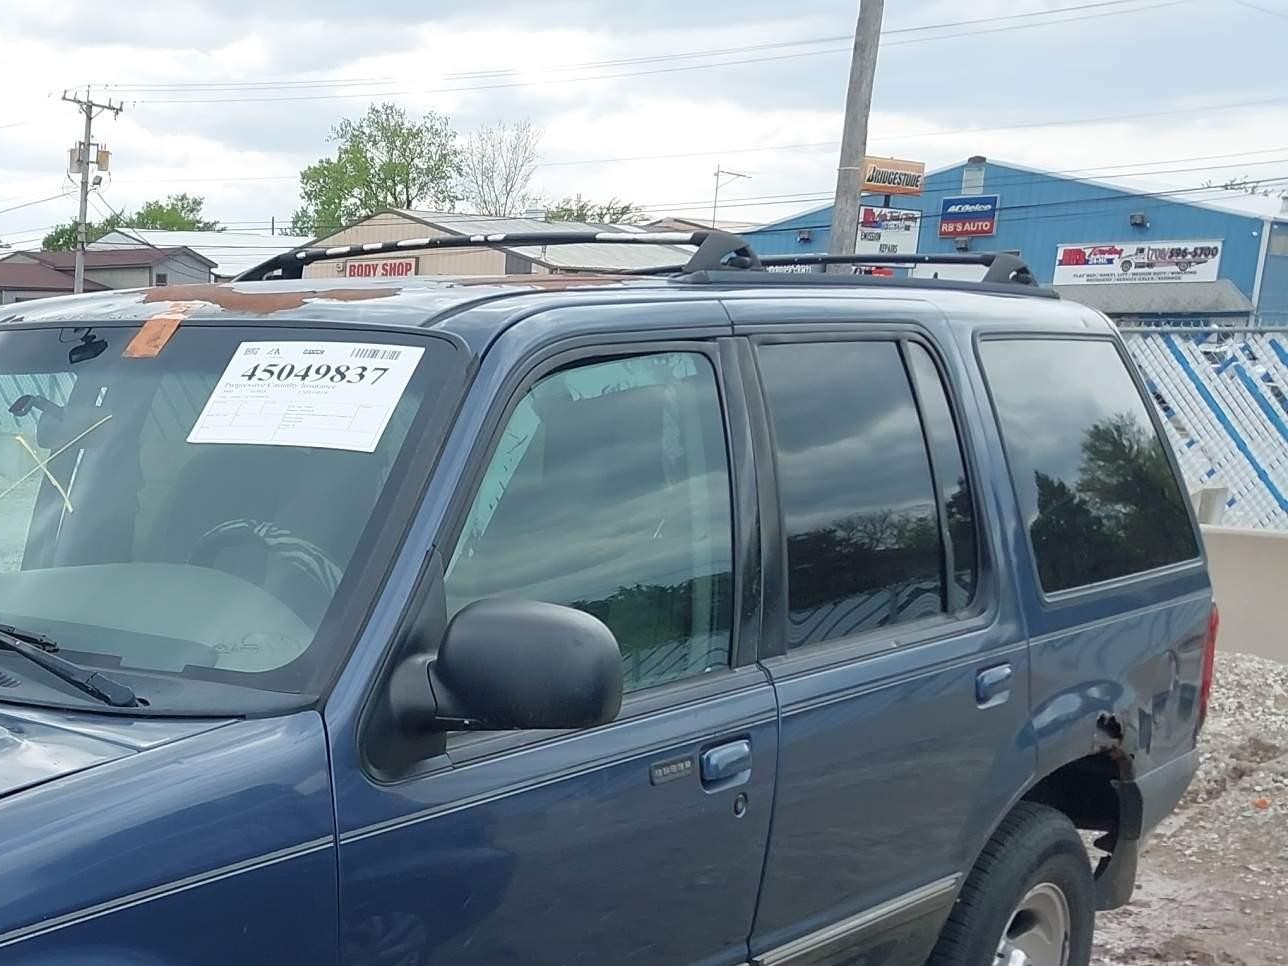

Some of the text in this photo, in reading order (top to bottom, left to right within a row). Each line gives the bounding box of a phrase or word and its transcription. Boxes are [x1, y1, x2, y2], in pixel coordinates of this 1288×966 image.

[866, 166, 921, 188] BRIDGESTONE
[941, 221, 991, 232] RB'S AUTO
[878, 243, 899, 254] REPAIRS
[348, 262, 413, 277] BODY SHOP
[240, 362, 390, 385] 45049837
